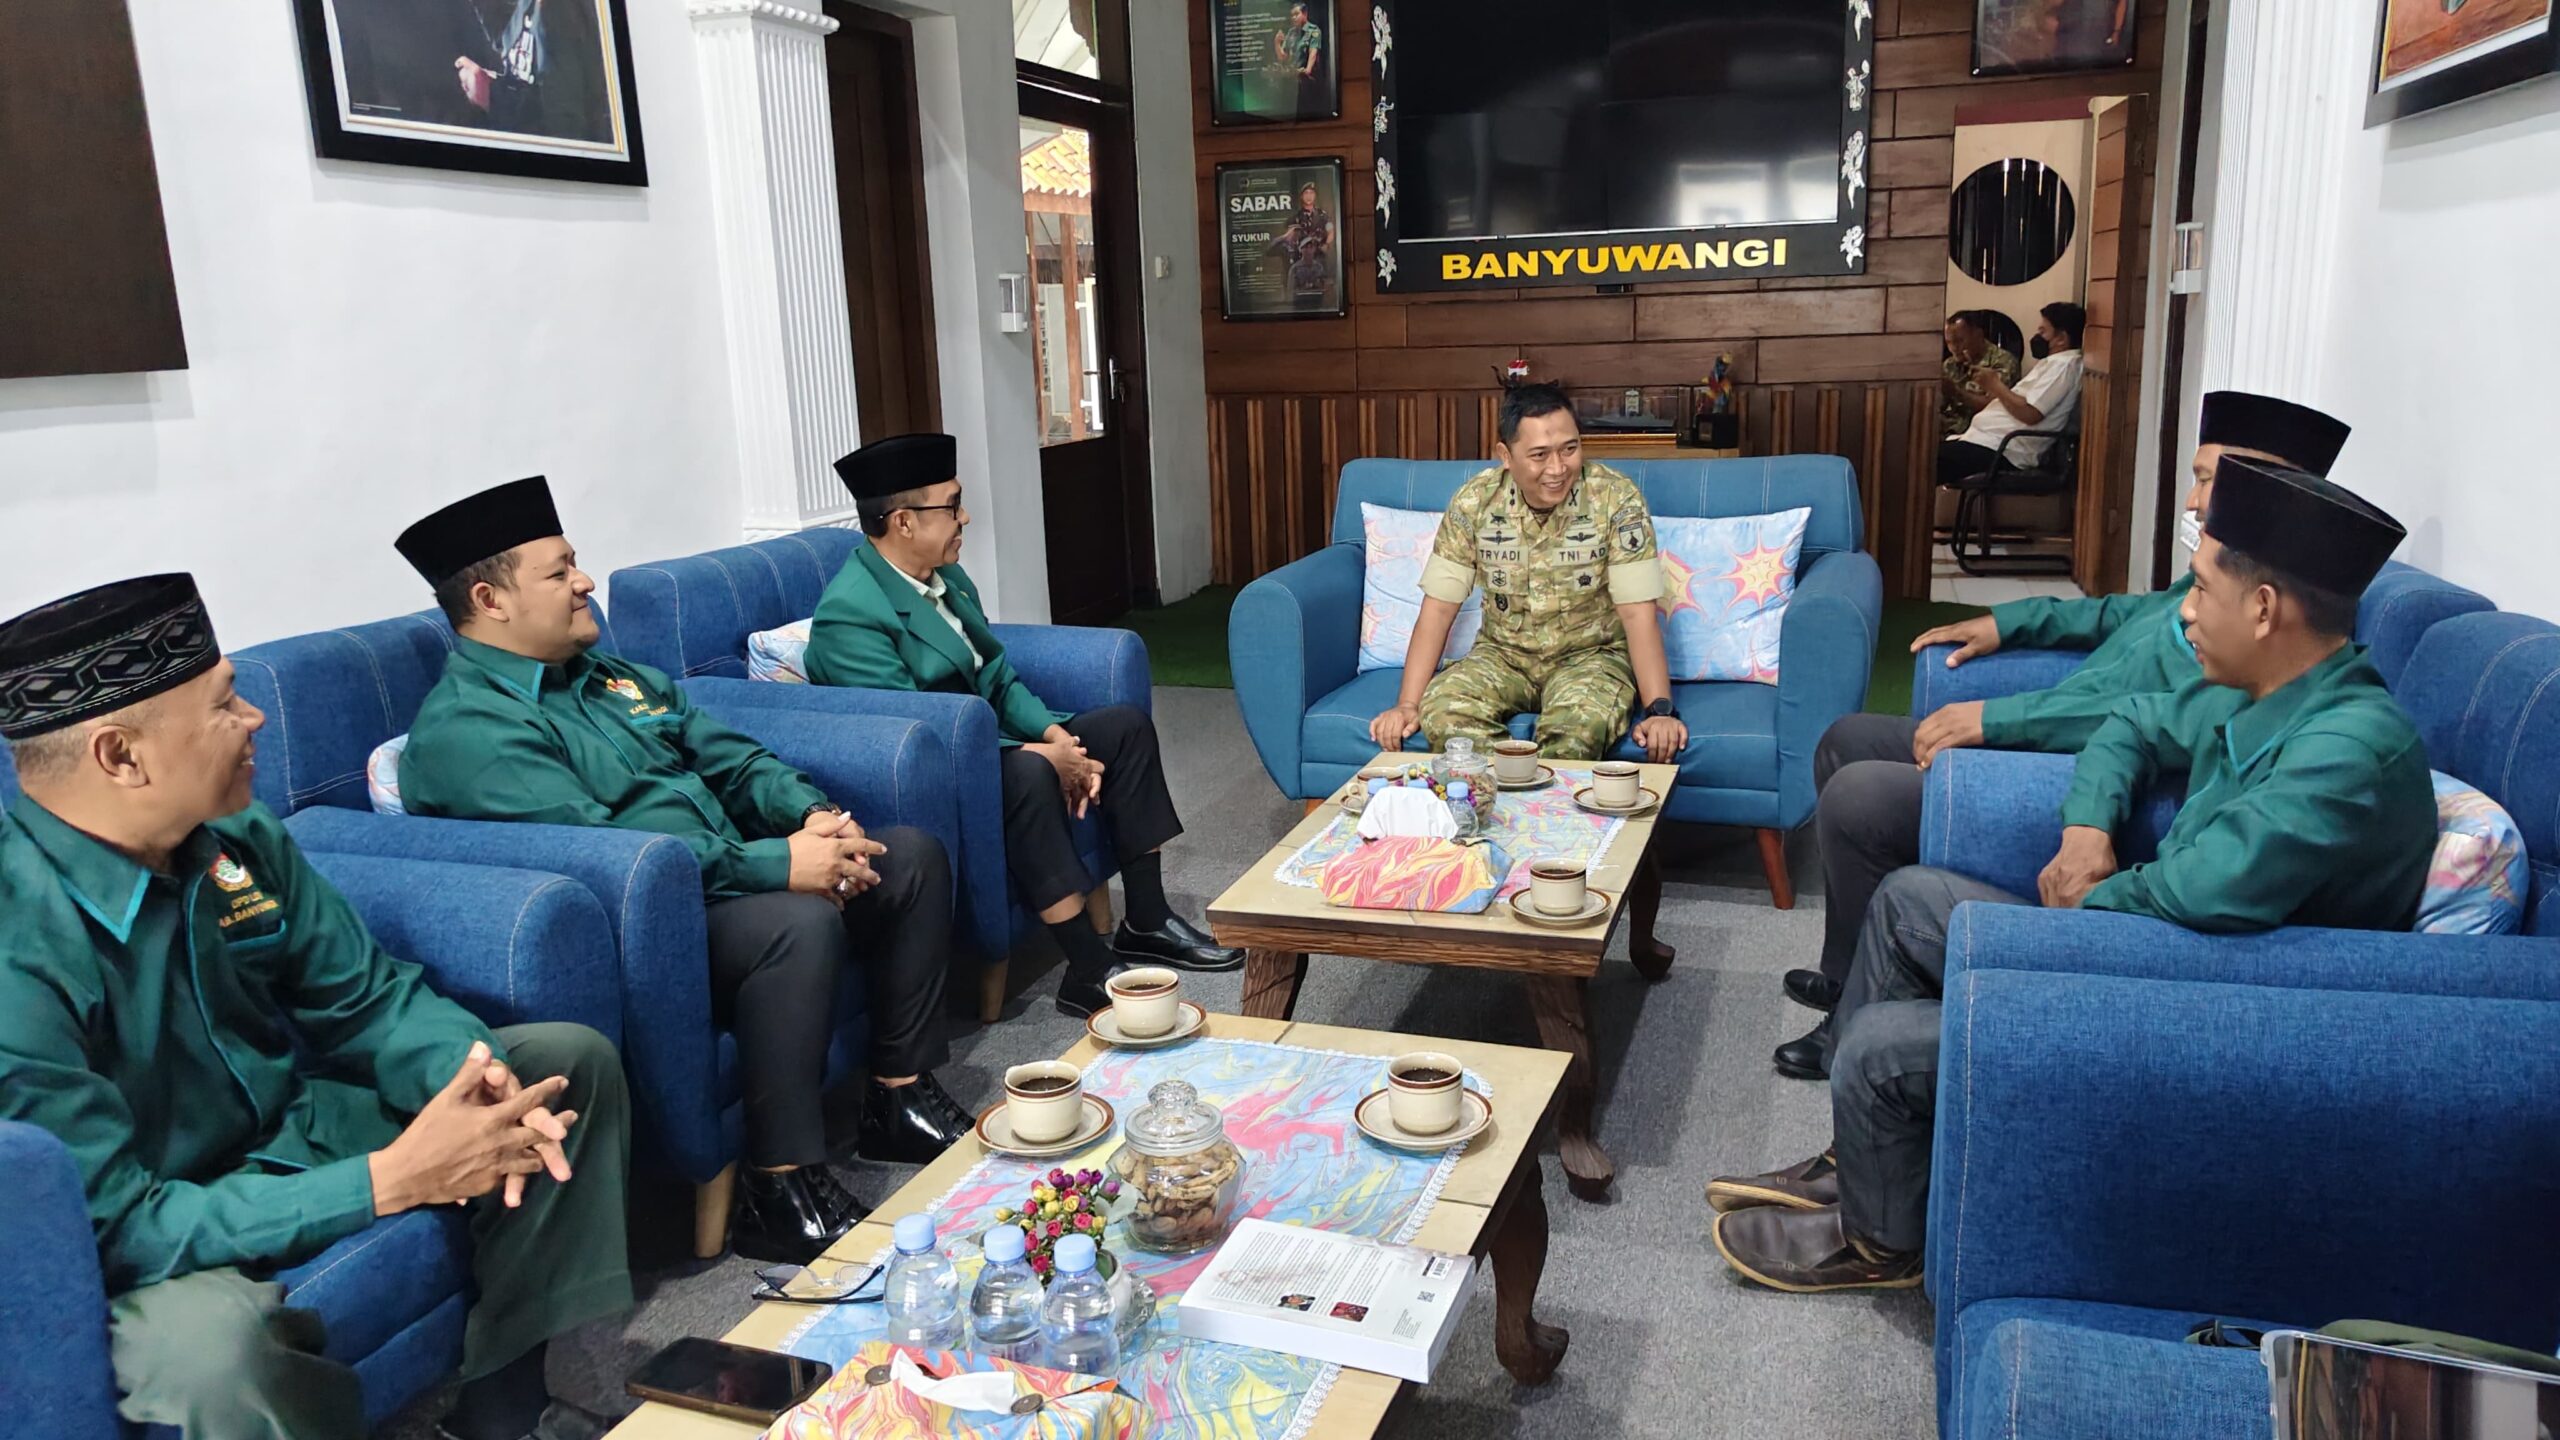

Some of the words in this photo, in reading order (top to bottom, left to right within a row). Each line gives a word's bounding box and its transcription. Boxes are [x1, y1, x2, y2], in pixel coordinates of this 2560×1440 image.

[1230, 194, 1292, 213] SABAR
[1231, 232, 1271, 243] SYUKUR
[1441, 238, 1787, 280] BANYUWANGI
[1479, 549, 1521, 562] TRYADI
[1558, 551, 1581, 562] TNI
[1589, 546, 1607, 560] AD
